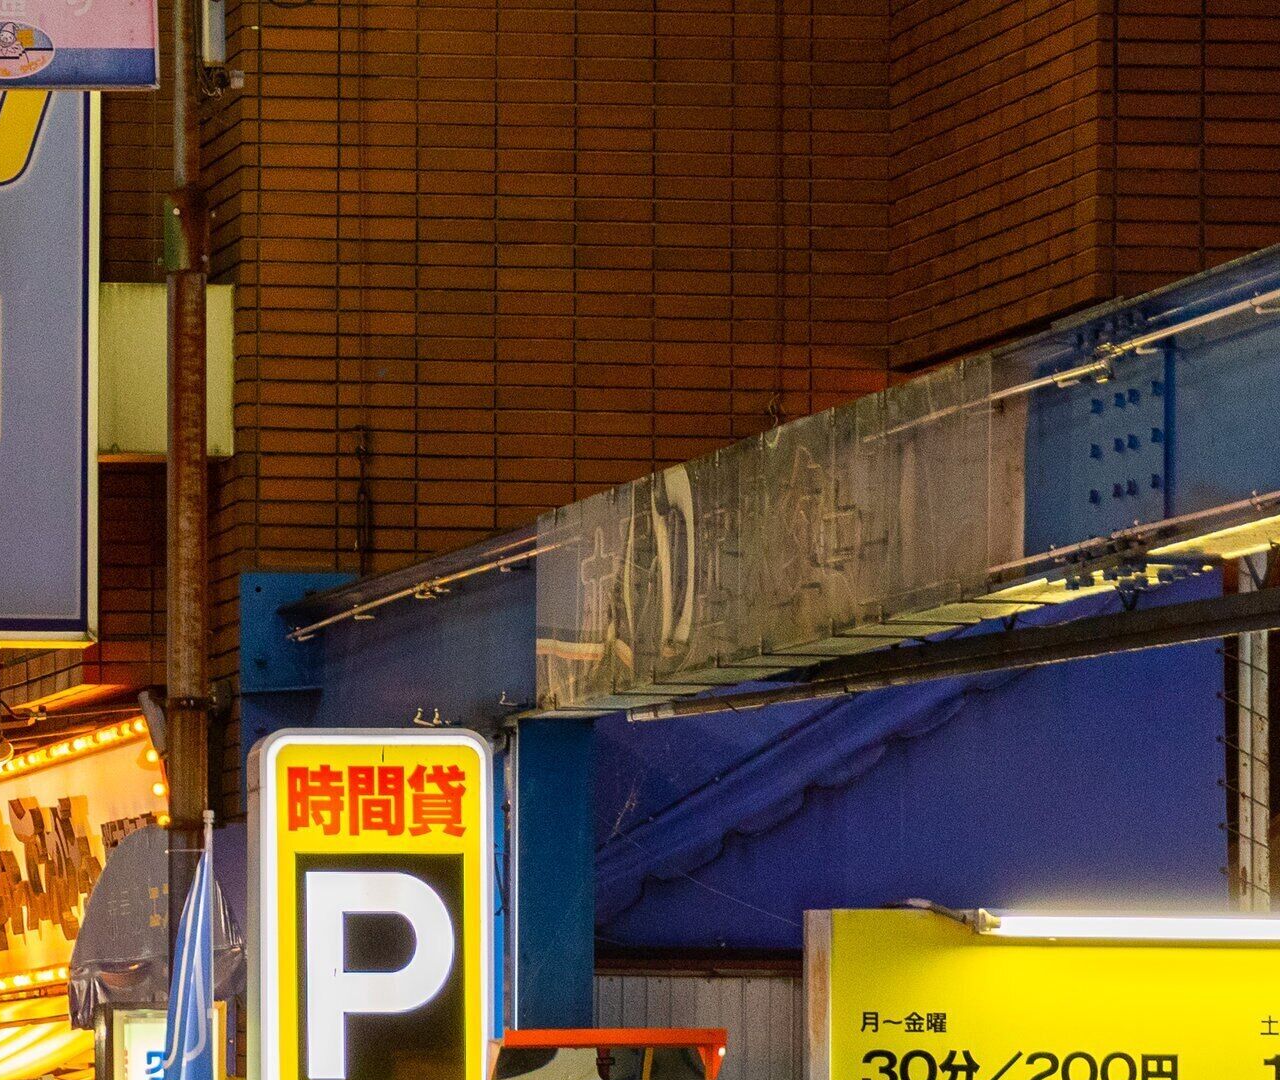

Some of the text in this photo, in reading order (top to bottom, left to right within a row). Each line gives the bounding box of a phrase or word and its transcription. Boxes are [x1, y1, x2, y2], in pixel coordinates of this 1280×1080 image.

[286, 764, 467, 837] 時間貸
[306, 871, 455, 1080] P
